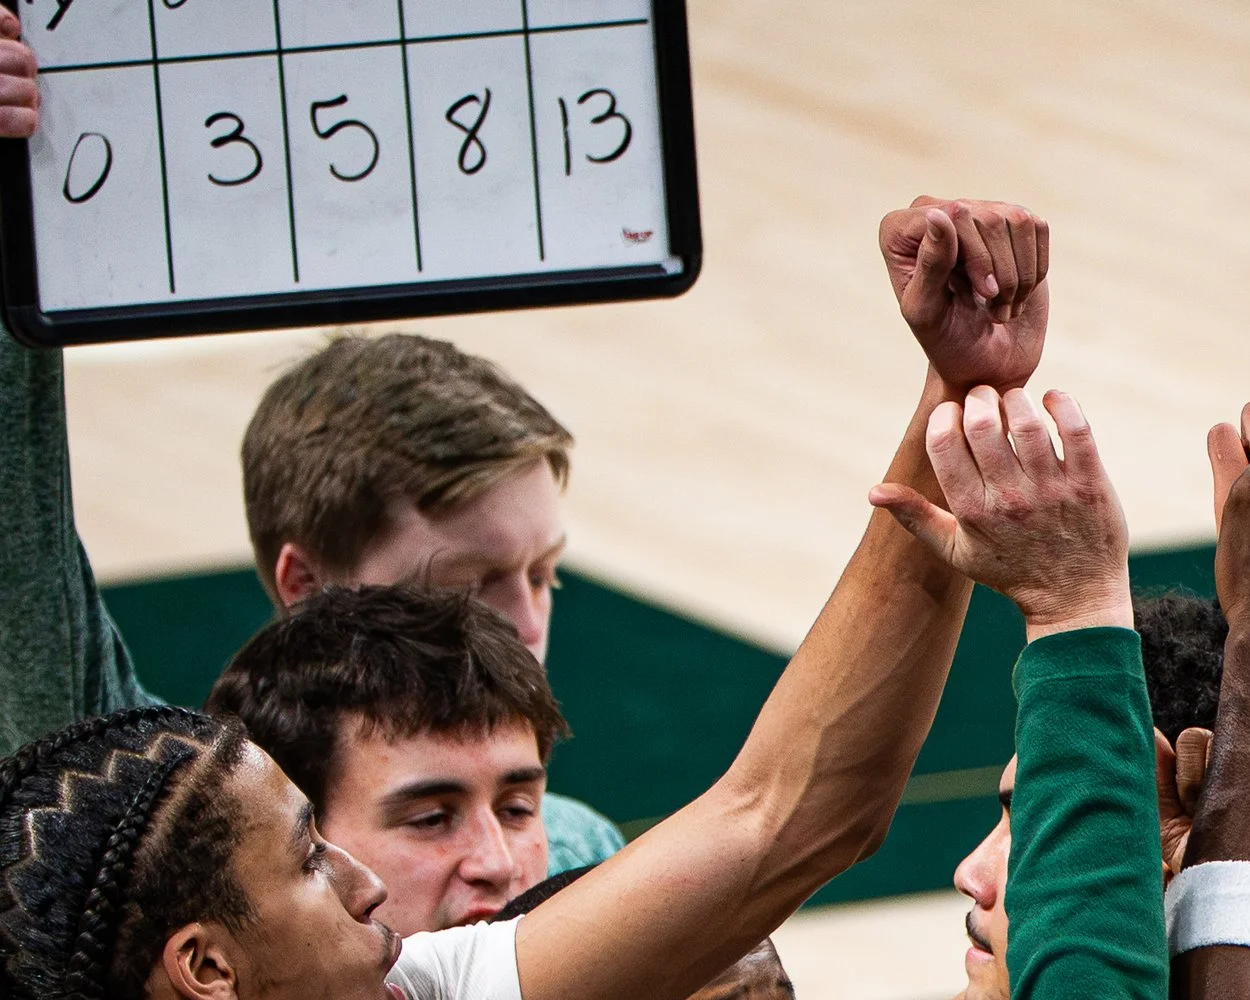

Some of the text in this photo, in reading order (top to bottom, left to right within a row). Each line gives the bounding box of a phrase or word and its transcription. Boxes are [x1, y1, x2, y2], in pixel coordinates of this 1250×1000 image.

[63, 88, 633, 203] 0 3 5 8 13
